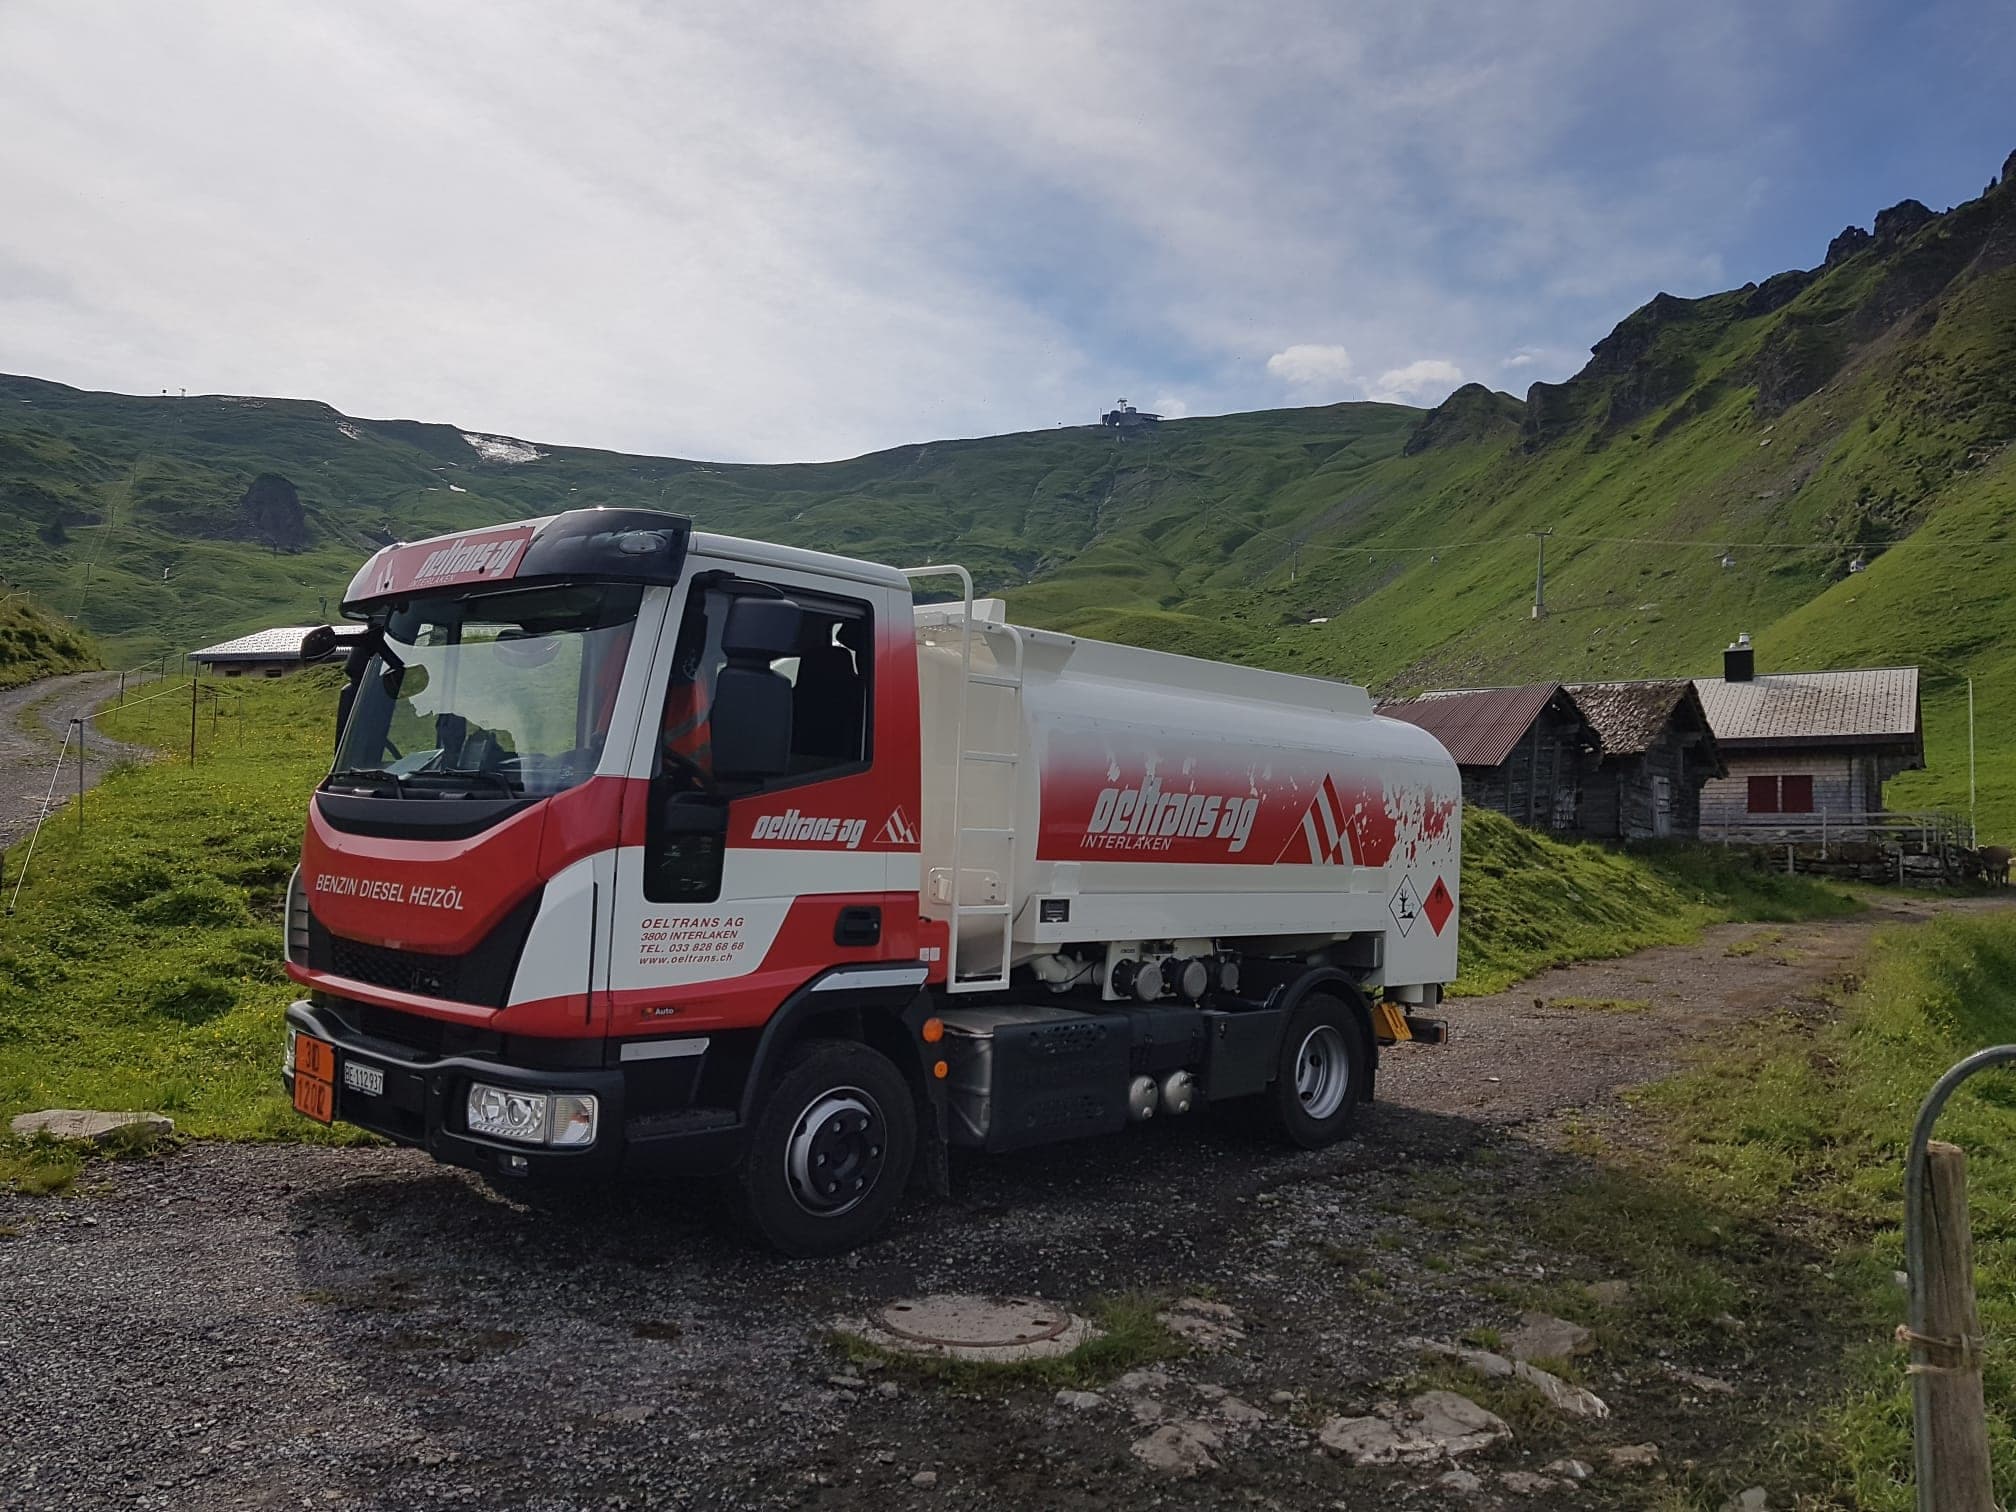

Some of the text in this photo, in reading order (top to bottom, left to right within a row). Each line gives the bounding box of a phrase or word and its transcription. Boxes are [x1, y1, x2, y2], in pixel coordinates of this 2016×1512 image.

[1087, 775, 1260, 852] oeltrans ag
[751, 809, 868, 848] oeltrans ag
[1080, 834, 1172, 850] INTERLAKEN
[315, 874, 464, 910] BENZIN DIESEL HEIZÖL
[641, 917, 744, 928] OELTRANS AG
[641, 930, 738, 941] 3800 INTERLAKEN
[640, 941, 745, 953] TEL. 033 828 68 68
[640, 953, 732, 965] www.oeltrans.ch
